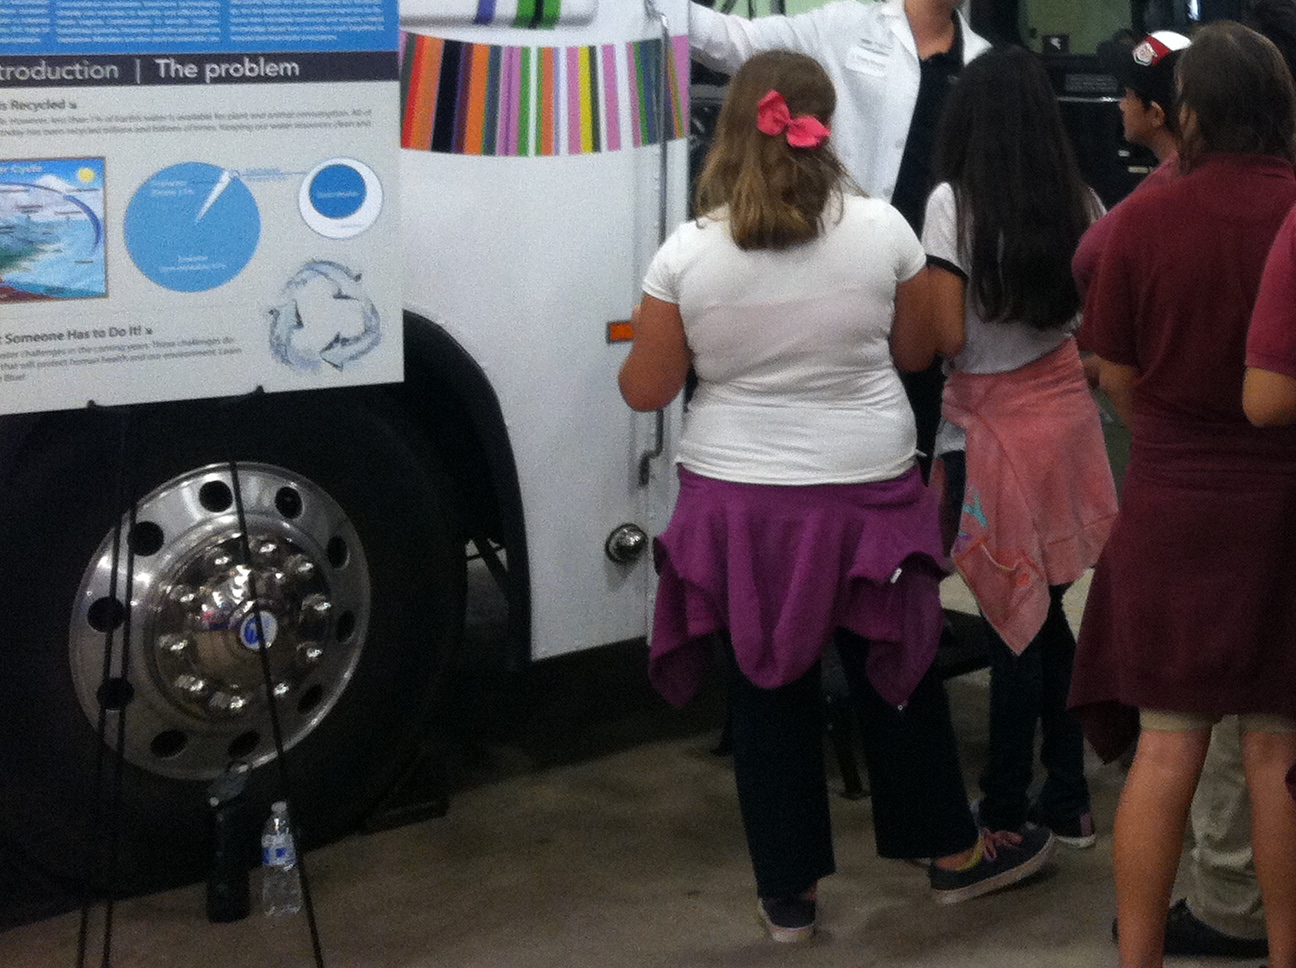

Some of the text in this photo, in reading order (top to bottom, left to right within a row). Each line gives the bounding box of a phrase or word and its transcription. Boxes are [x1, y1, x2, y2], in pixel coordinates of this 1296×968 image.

[153, 57, 199, 79] The
[204, 56, 300, 84] problem
[11, 98, 66, 112] Recycled
[4, 332, 65, 345] Someone
[67, 328, 90, 341] Has
[91, 328, 107, 340] to
[109, 326, 127, 338] Do
